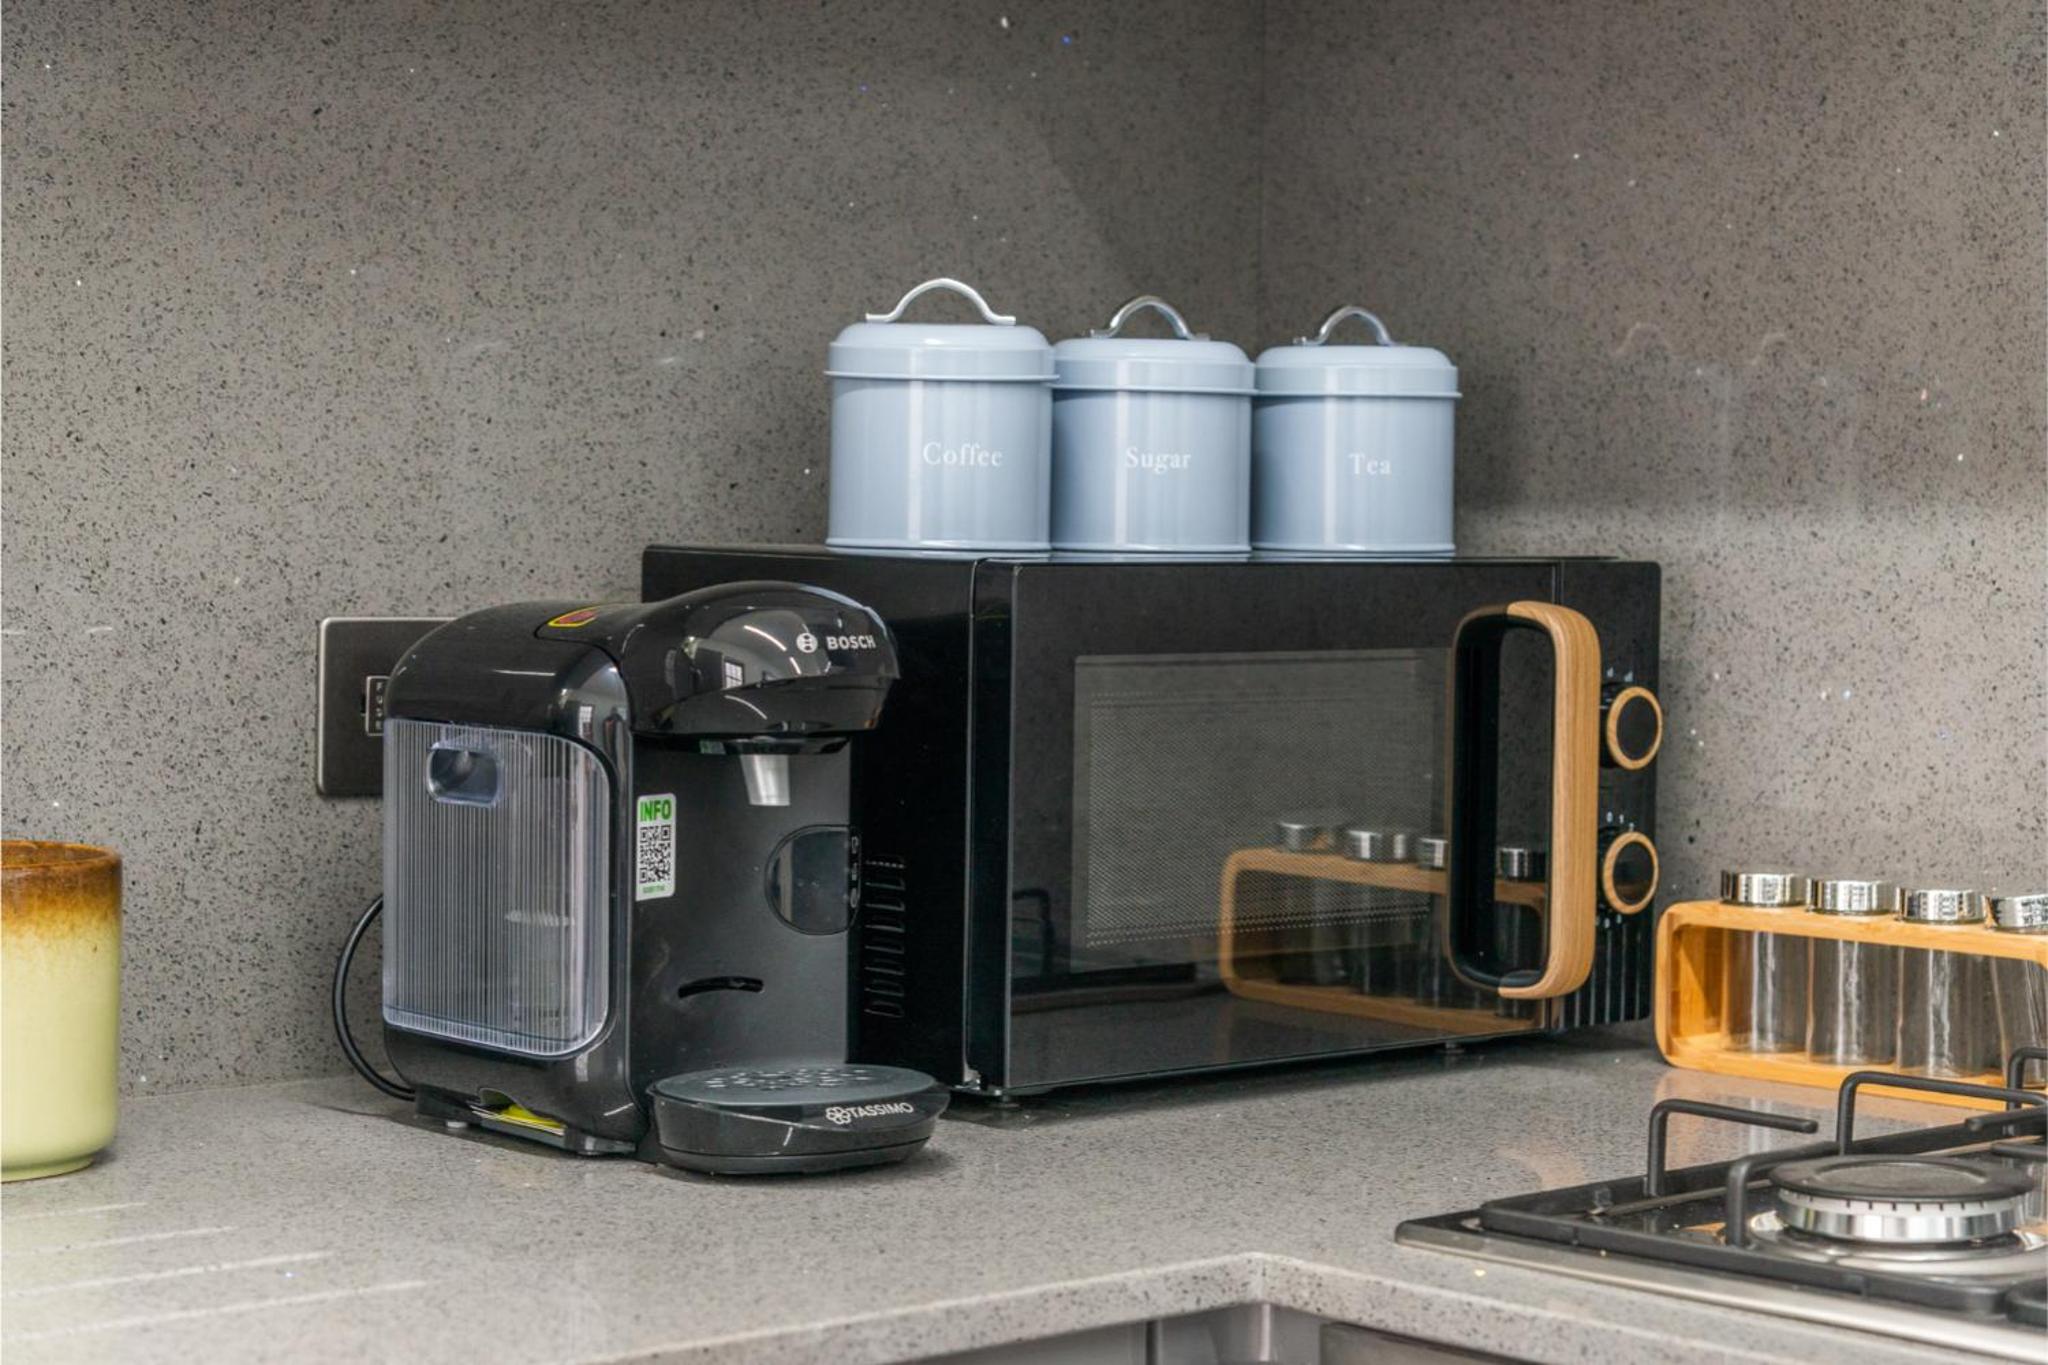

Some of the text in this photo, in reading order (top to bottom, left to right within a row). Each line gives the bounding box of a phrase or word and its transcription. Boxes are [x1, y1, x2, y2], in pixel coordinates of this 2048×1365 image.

[923, 441, 1003, 466] Coffee
[1125, 447, 1192, 475] Sugar
[1347, 452, 1391, 476] Tea
[826, 635, 876, 651] BOSCH
[640, 799, 672, 822] INFO
[846, 1102, 914, 1119] TASSIMO
